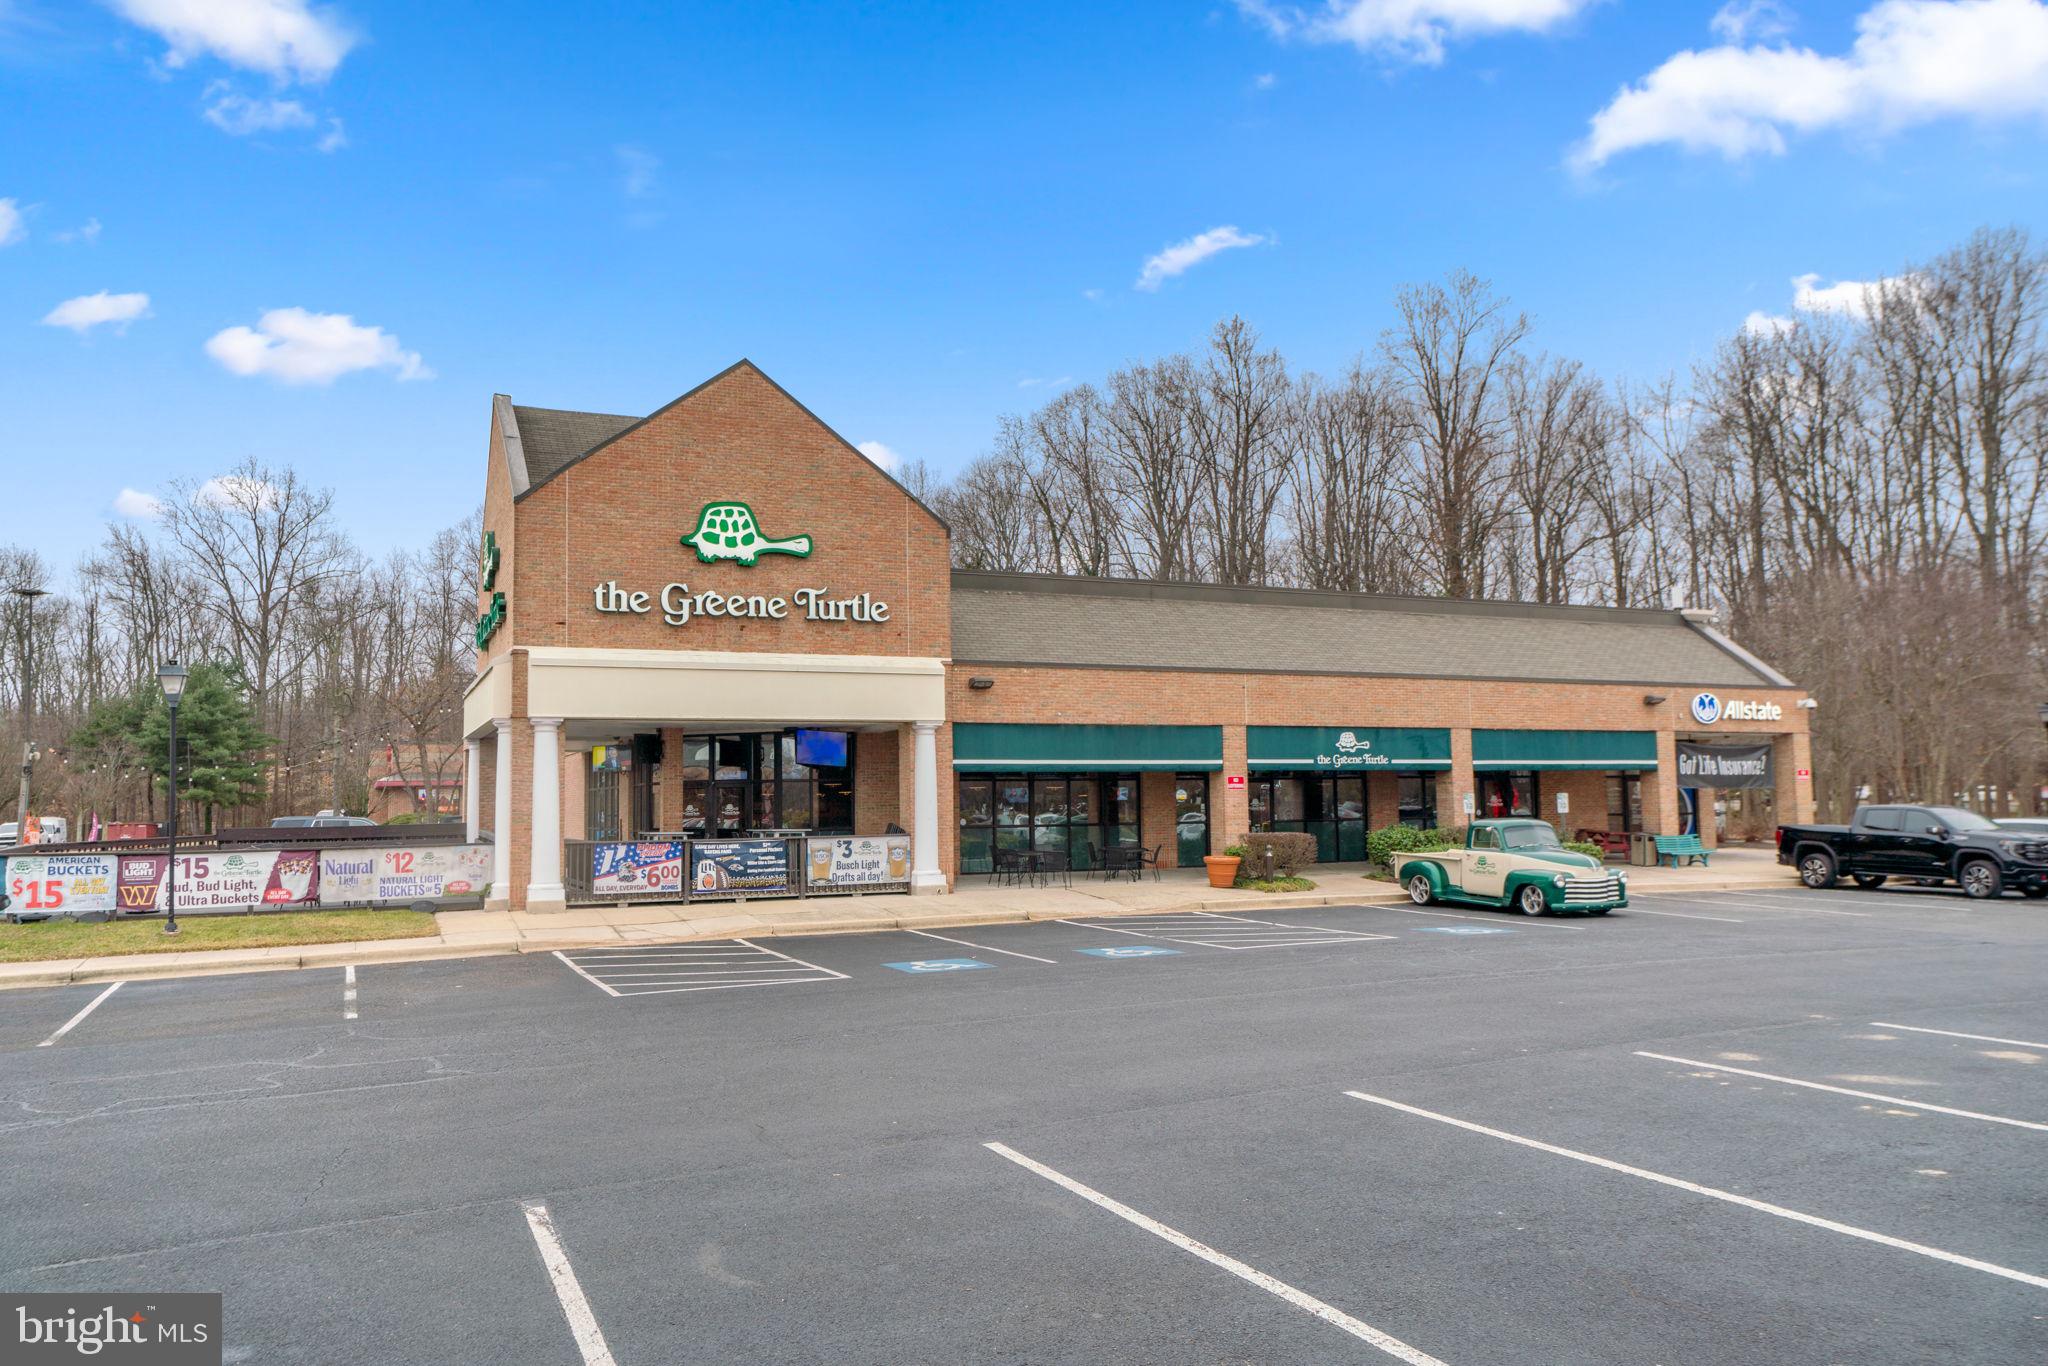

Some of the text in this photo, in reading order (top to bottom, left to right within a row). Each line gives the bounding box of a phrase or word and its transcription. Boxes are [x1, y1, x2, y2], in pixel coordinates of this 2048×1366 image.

[593, 580, 890, 626] the Greene Turtle
[1722, 700, 1782, 721] Allstate
[1317, 753, 1389, 768] the Greene Turtle
[1679, 754, 1767, 776] Got Life Insurance?
[836, 840, 852, 858] $3
[48, 856, 101, 865] AMERICAN
[128, 861, 150, 870] BUD
[325, 859, 374, 876] Natural
[385, 852, 414, 874] $12
[836, 859, 880, 871] Busch Light
[47, 865, 109, 876] BUCKETS
[124, 868, 155, 877] LIGHT
[173, 857, 209, 880] $15
[338, 875, 359, 889] Light
[379, 875, 443, 885] NATURAL LIGHT
[832, 870, 884, 883] Drafts all day!
[196, 880, 221, 892] Bud
[223, 879, 257, 892] Light,
[379, 884, 425, 898] BUCKETS
[434, 883, 442, 895] 5
[619, 884, 648, 892] EVERYDAY
[12, 878, 64, 910] $15
[178, 894, 208, 906] Ultra
[211, 892, 260, 905] Buckets
